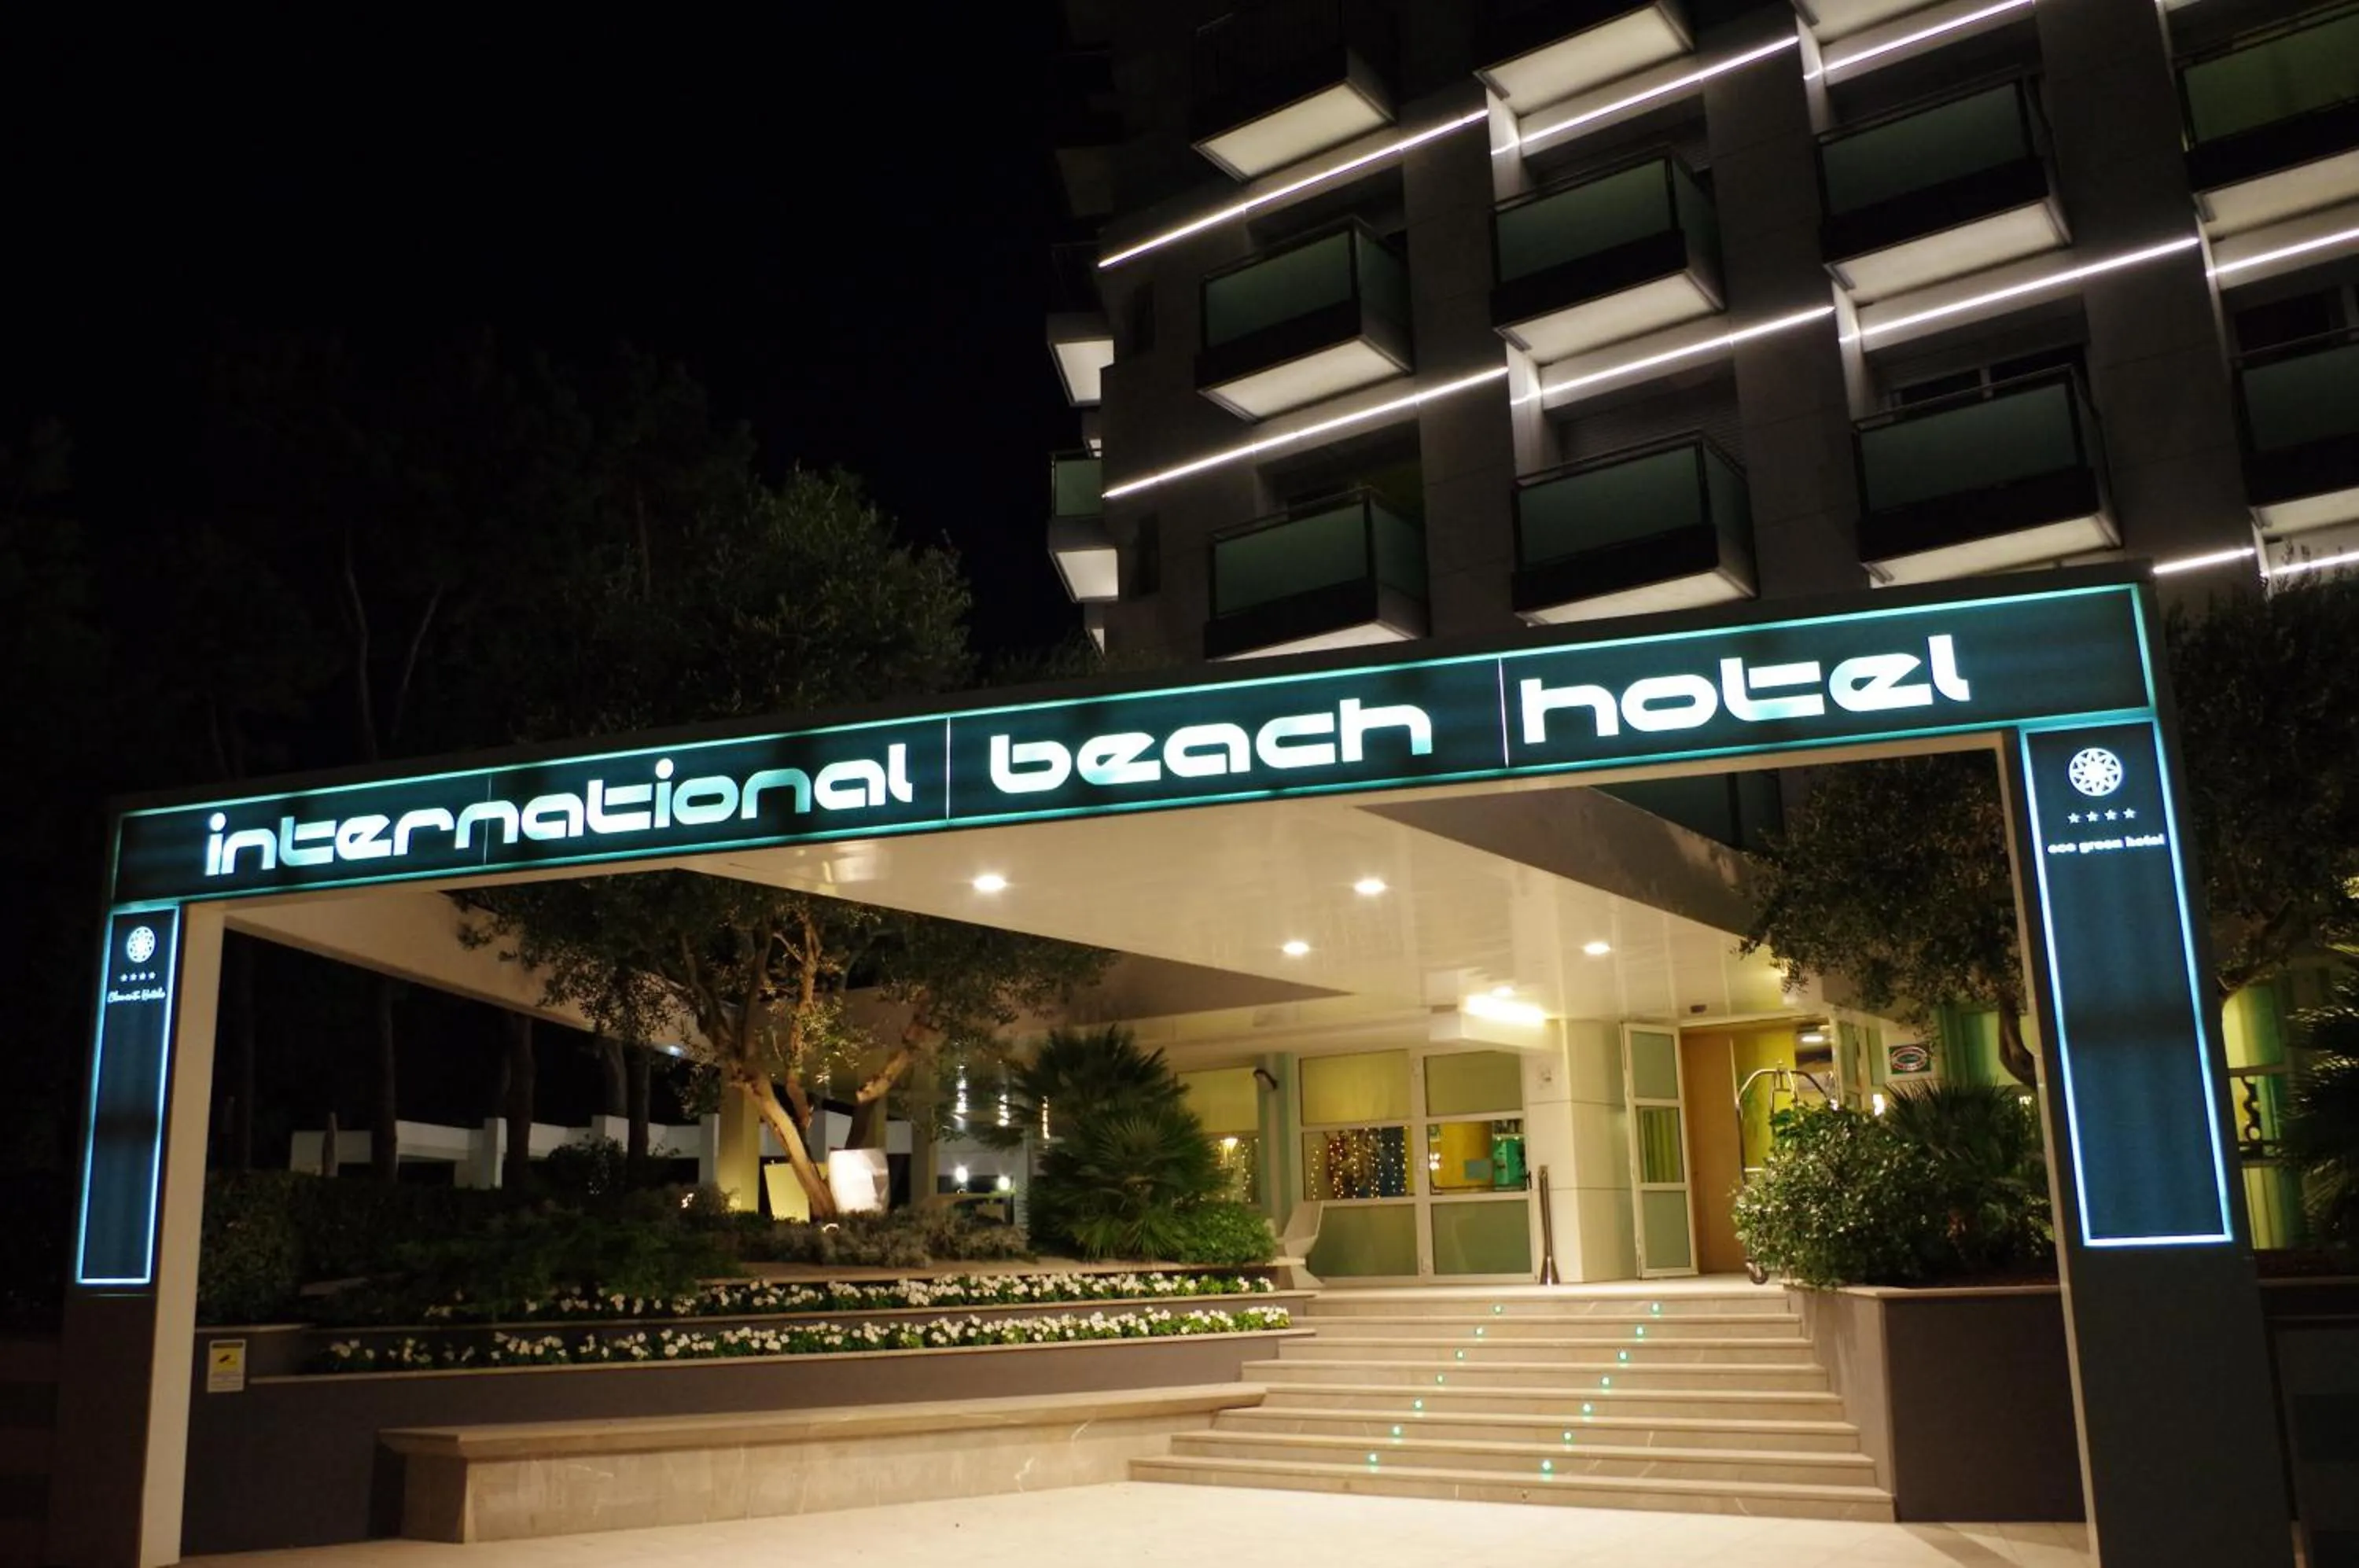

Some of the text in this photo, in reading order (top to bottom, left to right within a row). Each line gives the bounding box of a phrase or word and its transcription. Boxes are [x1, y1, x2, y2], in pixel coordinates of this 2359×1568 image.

[204, 634, 1972, 877] international beach hotel
[2078, 839, 2124, 854] green
[2125, 833, 2166, 847] hotel
